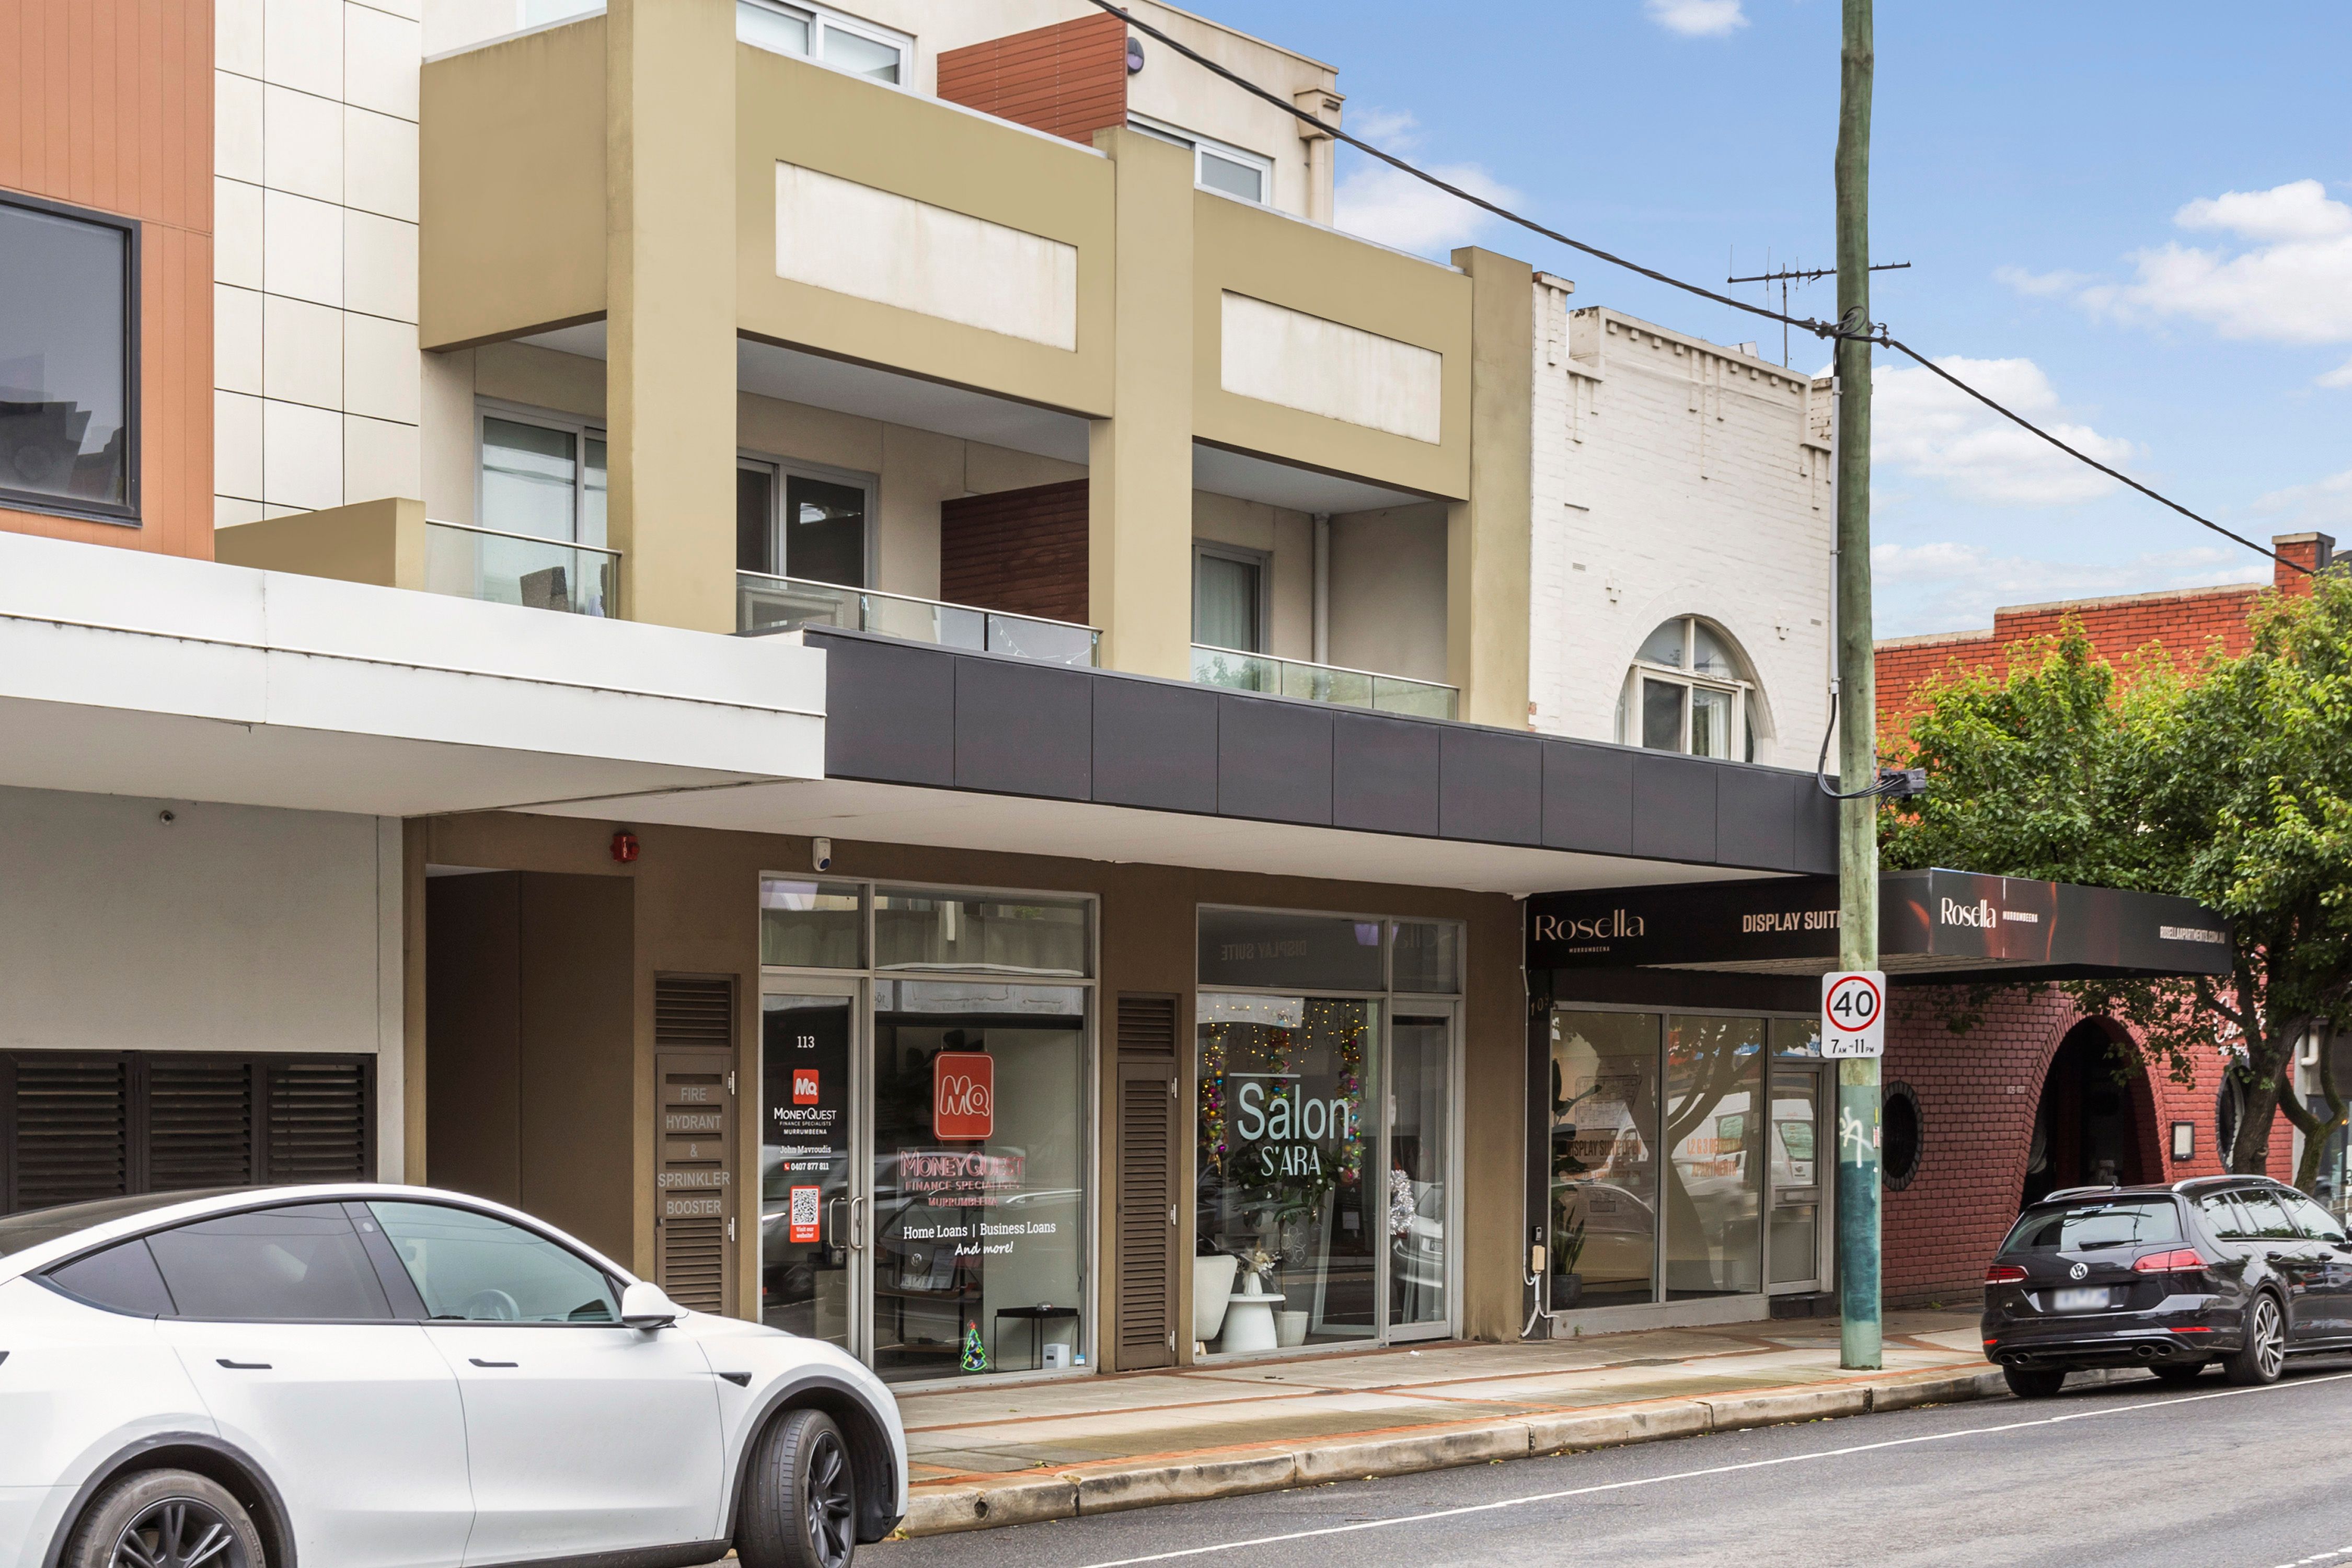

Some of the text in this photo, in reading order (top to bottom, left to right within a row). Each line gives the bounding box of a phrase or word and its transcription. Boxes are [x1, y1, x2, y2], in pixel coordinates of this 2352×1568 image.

[1941, 897, 1997, 928] Rosella
[1535, 908, 1644, 941] Rosella
[1743, 912, 1801, 933] DISPLAY
[1833, 990, 1873, 1017] 40
[797, 1035, 815, 1048] 113
[681, 1087, 707, 1101] FIRE
[1237, 1082, 1350, 1140] Salon
[666, 1115, 722, 1129] HYDRANT
[690, 1144, 698, 1158] &
[780, 1145, 832, 1154] John Mavroudis
[791, 1162, 829, 1171] 0407 877 811
[1261, 1146, 1322, 1177] S'ARA
[658, 1172, 730, 1187] SPRINKLER
[905, 1181, 952, 1191] FINANCE
[666, 1200, 722, 1215] BOOSTER
[928, 1197, 998, 1207] MURRUMBEENA
[903, 1226, 935, 1239] Home
[937, 1225, 968, 1238] Loans
[980, 1223, 1025, 1236] Business
[1027, 1221, 1056, 1234] Loans
[954, 1241, 1014, 1256] And more!
